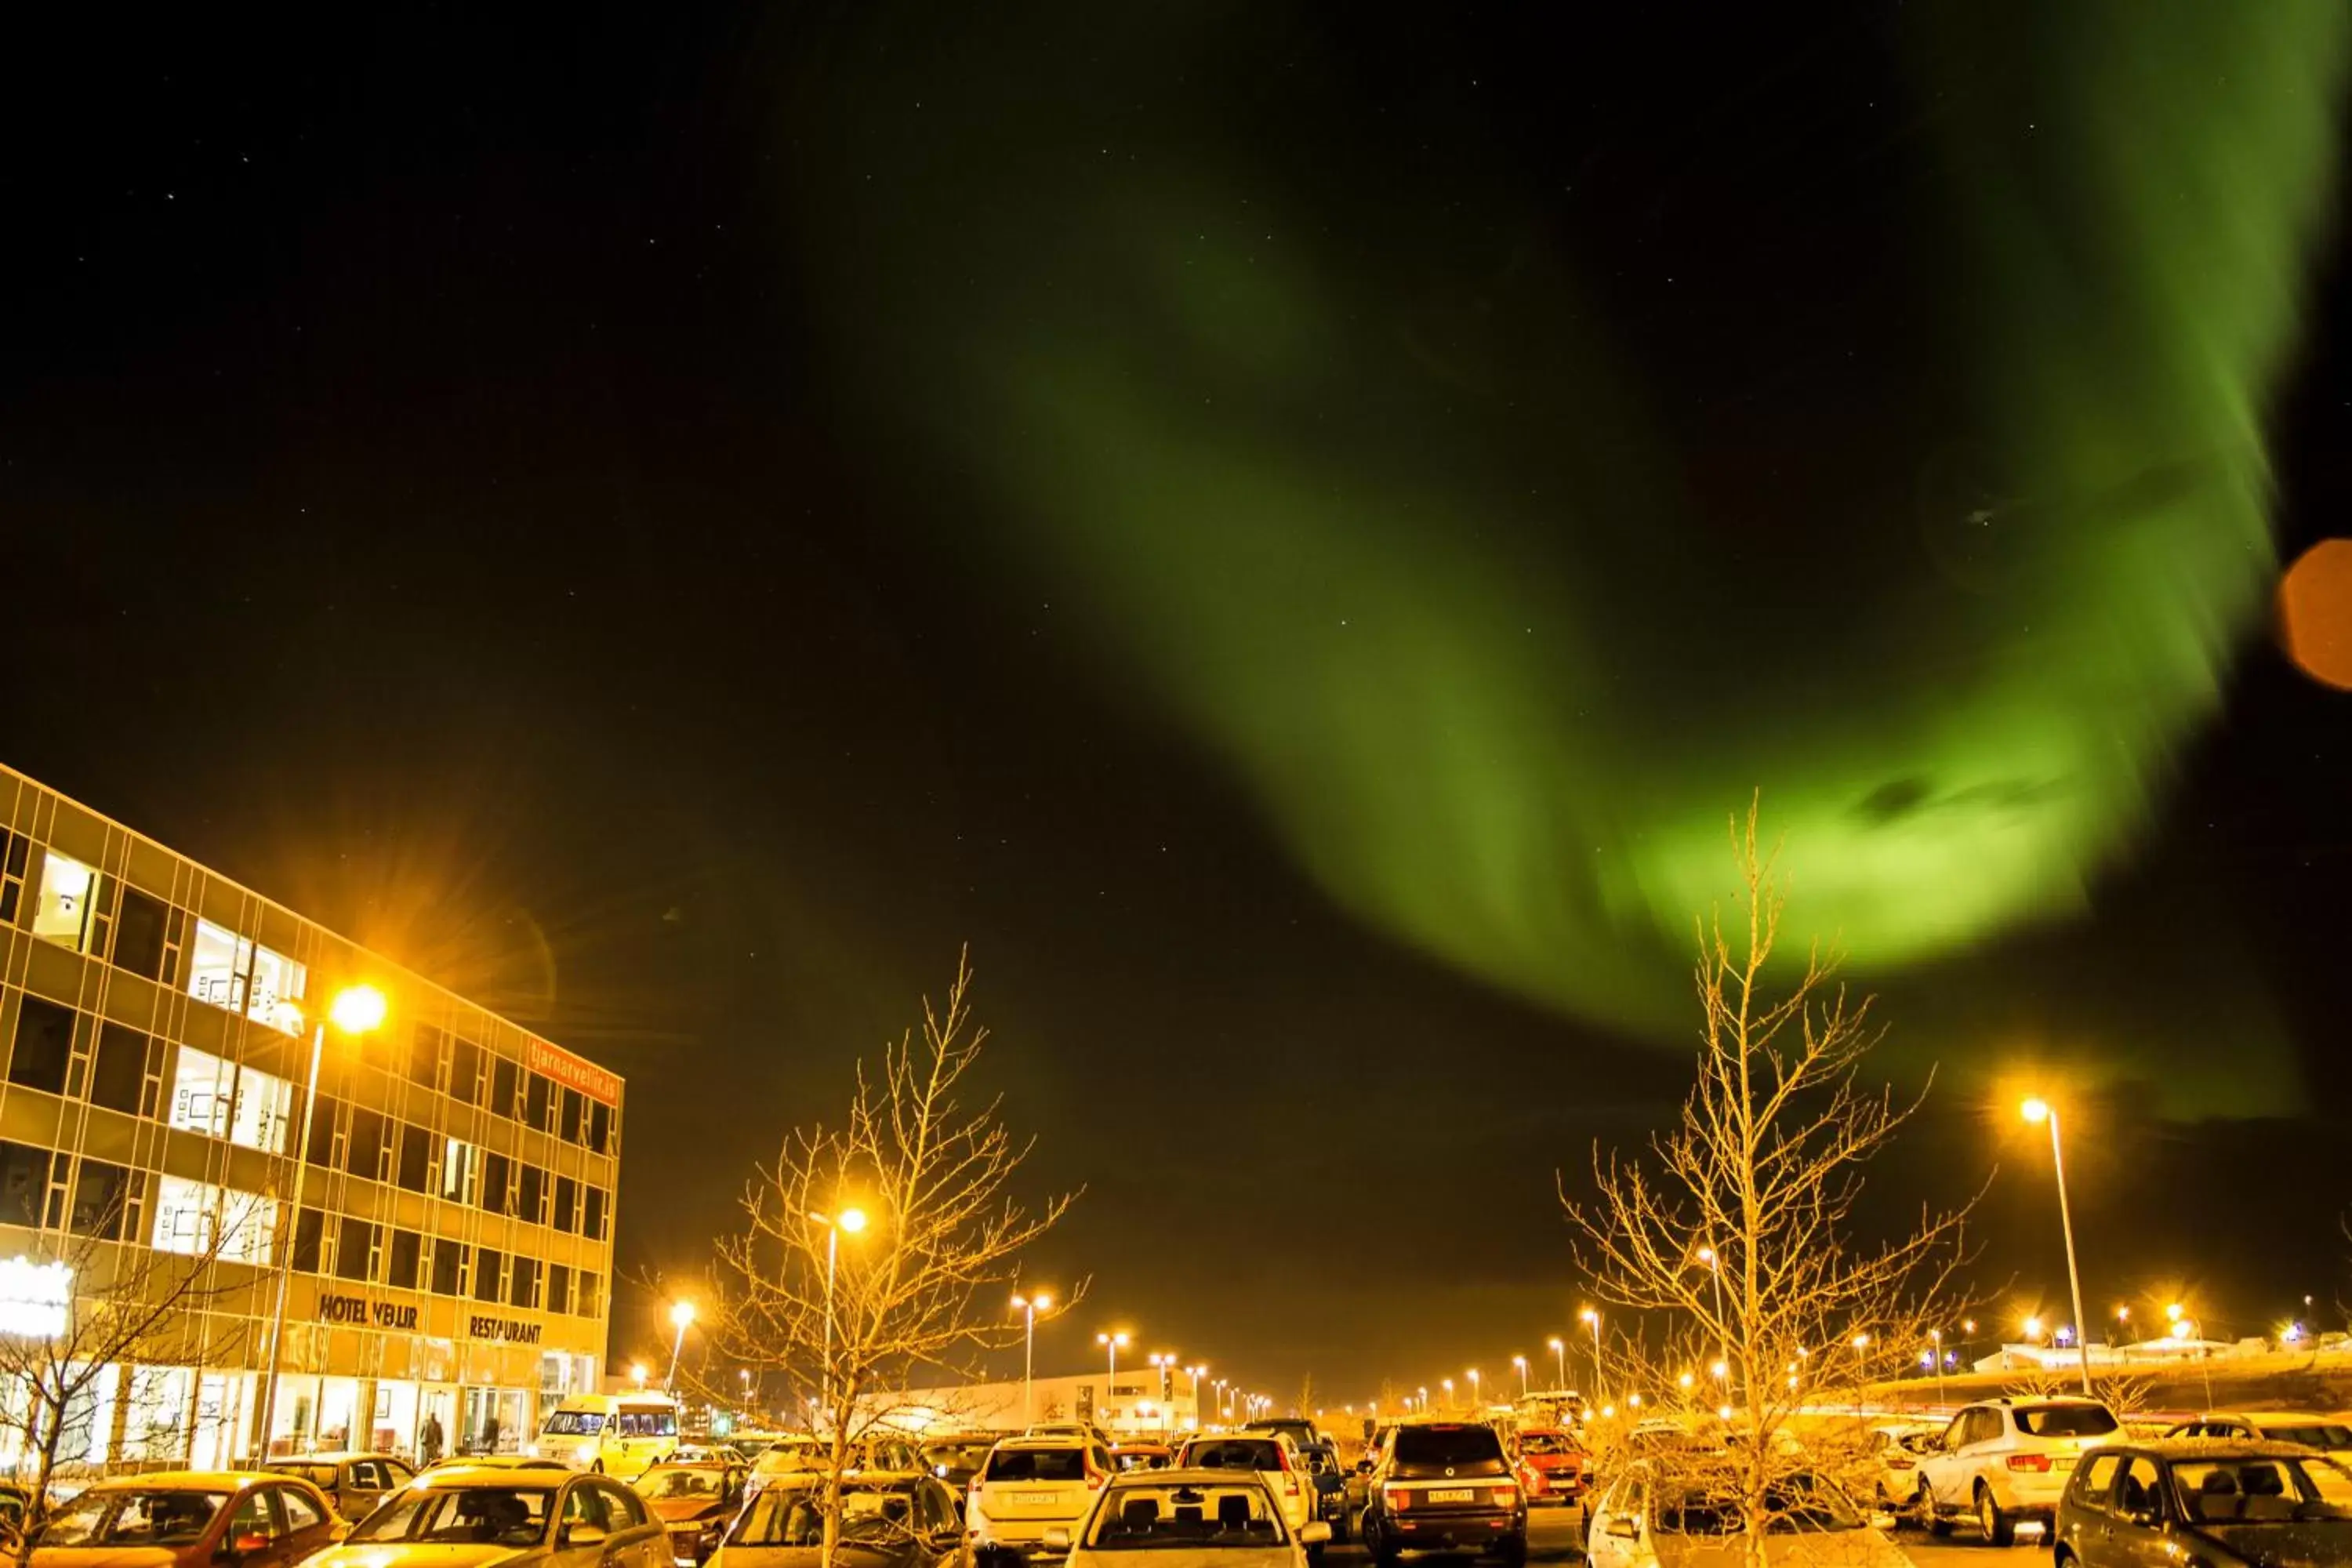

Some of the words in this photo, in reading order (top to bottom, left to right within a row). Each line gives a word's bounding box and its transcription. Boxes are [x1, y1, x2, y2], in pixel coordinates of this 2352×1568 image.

[319, 1294, 367, 1323] HOTEL
[372, 1301, 418, 1330] VELLIR
[470, 1316, 541, 1345] RESTAURANT
